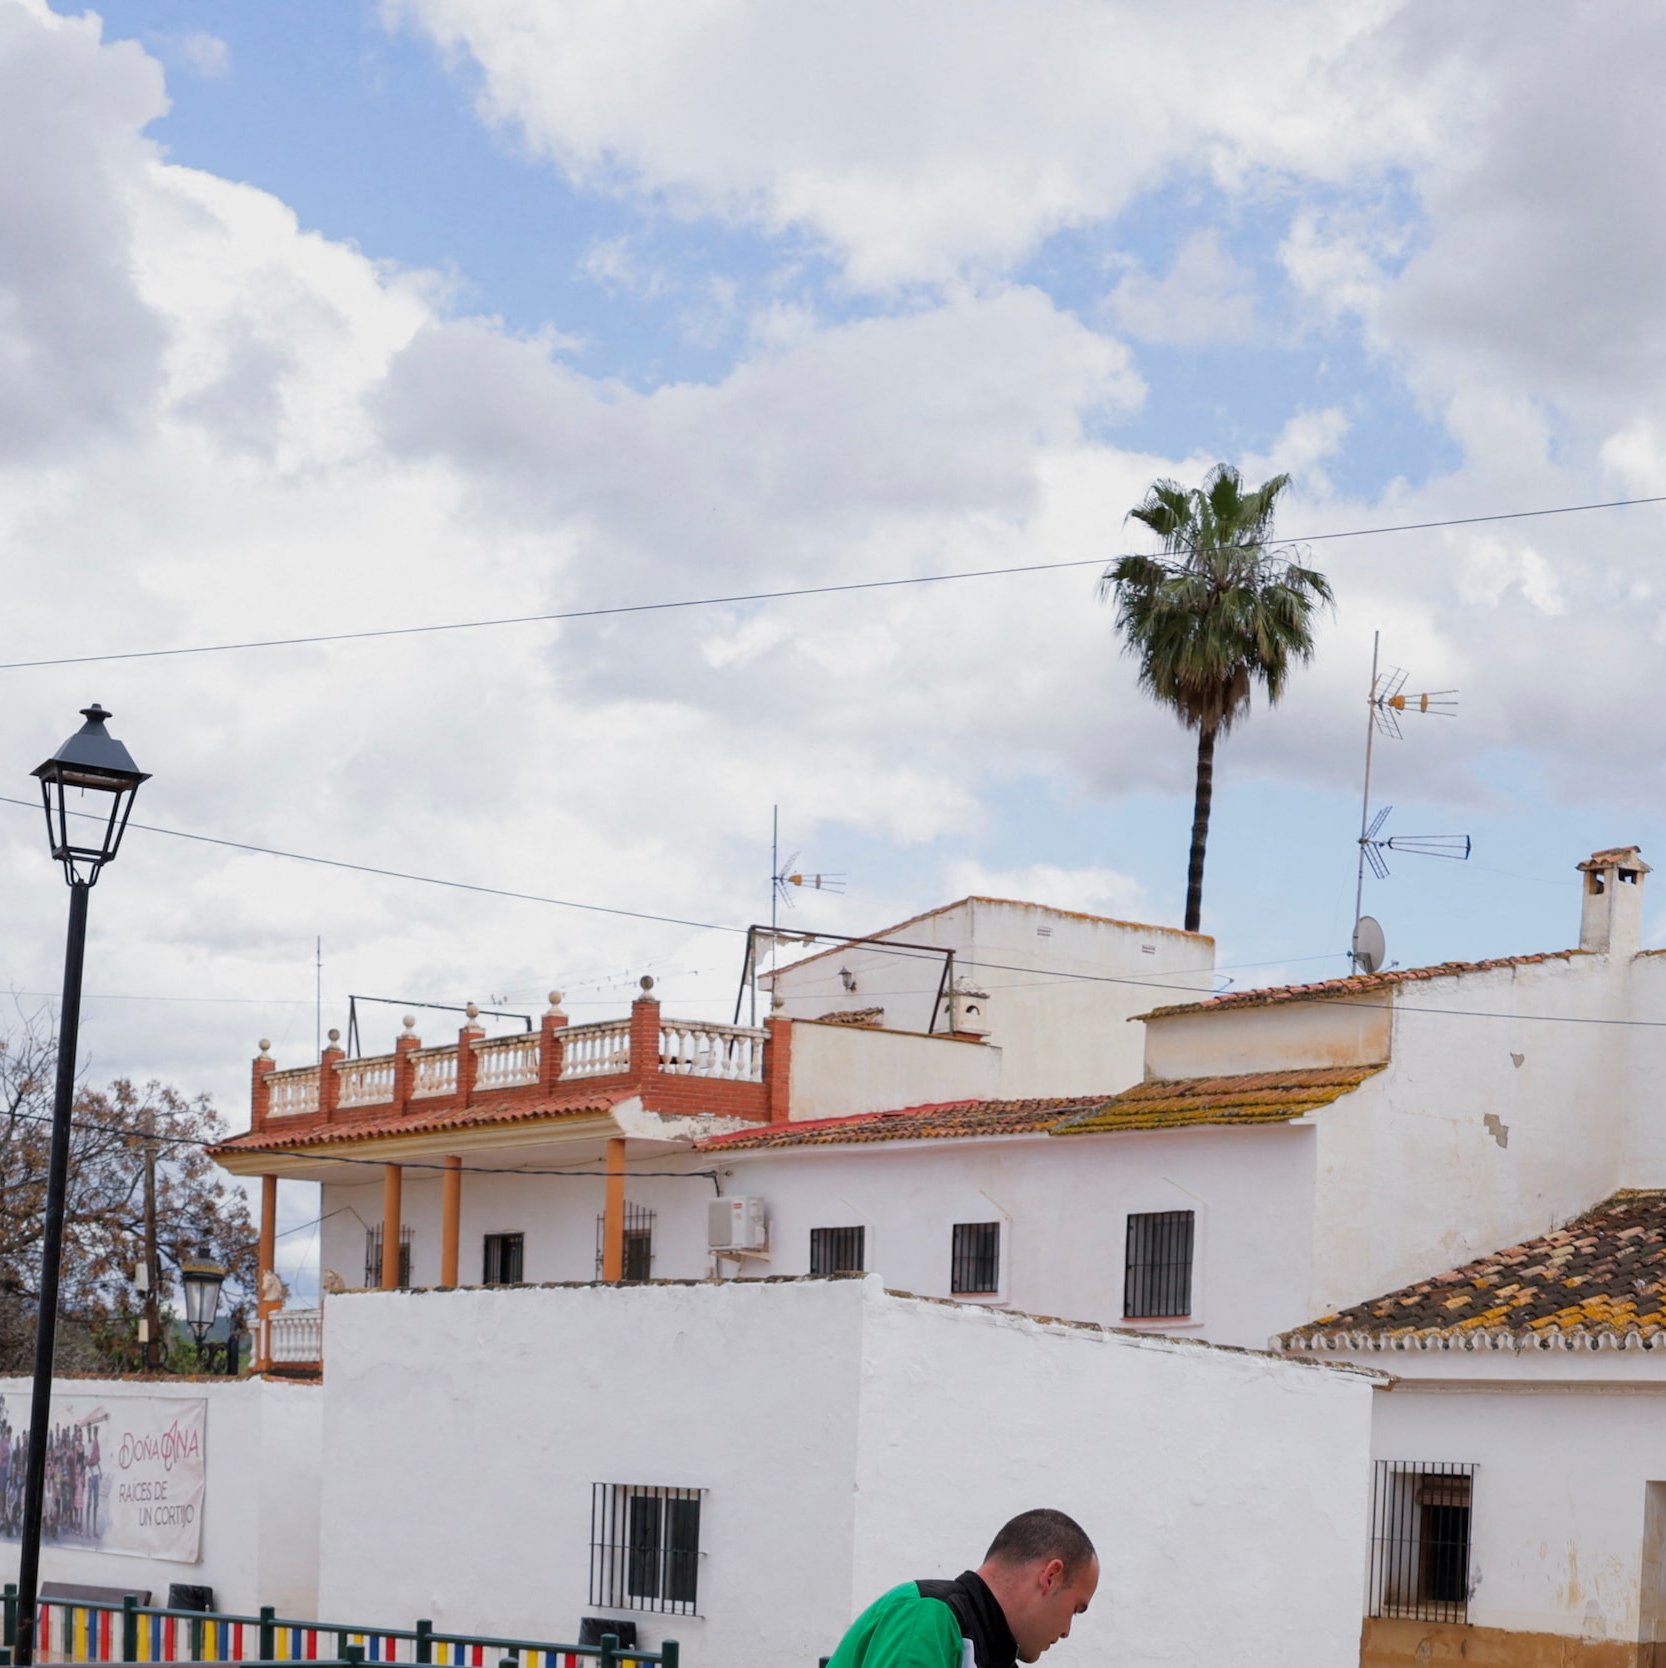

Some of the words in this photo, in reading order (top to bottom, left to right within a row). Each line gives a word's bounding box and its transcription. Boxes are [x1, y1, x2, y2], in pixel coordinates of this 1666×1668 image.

[119, 1477, 152, 1503] RAÍCES
[155, 1481, 168, 1501] DE
[139, 1507, 152, 1526] UN
[155, 1504, 195, 1528] CORTIJO
